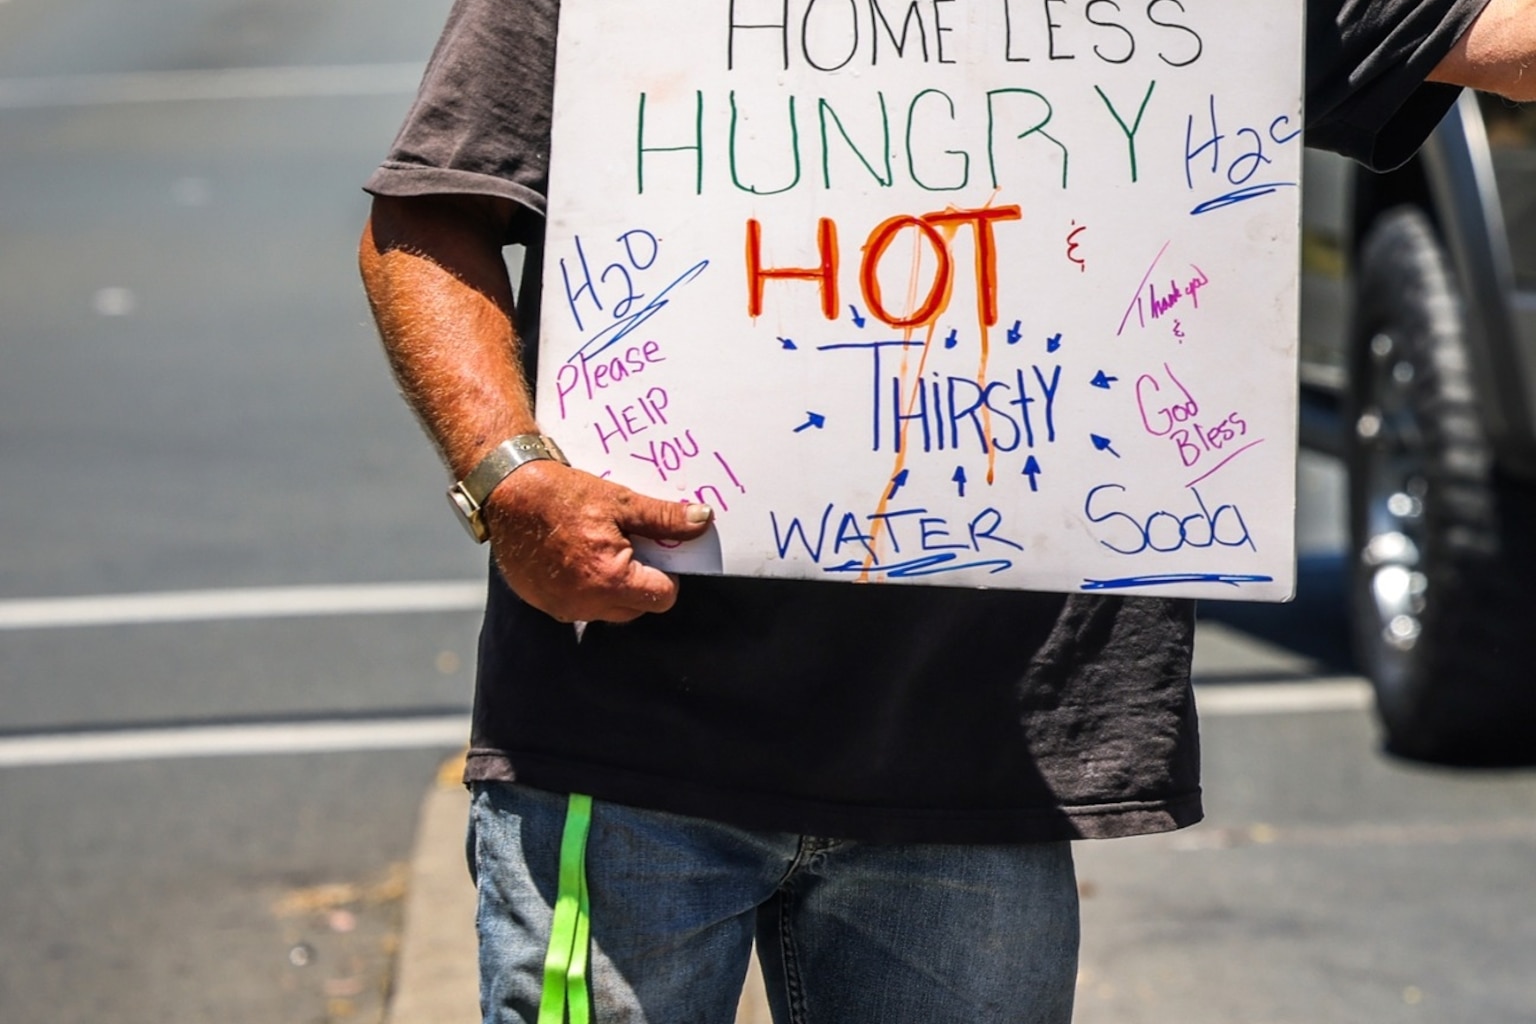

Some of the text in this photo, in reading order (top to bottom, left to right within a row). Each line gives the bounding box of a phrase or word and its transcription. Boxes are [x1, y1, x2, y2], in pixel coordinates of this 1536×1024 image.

[637, 79, 1156, 195] HUNGRY
[559, 228, 659, 332] H2O
[744, 203, 1022, 330] HOT
[555, 340, 667, 420] Please
[1135, 361, 1199, 437] God
[629, 429, 700, 482] YOU
[1168, 411, 1247, 467] Bless
[770, 502, 1025, 566] WATER
[1084, 484, 1258, 555] Soda
